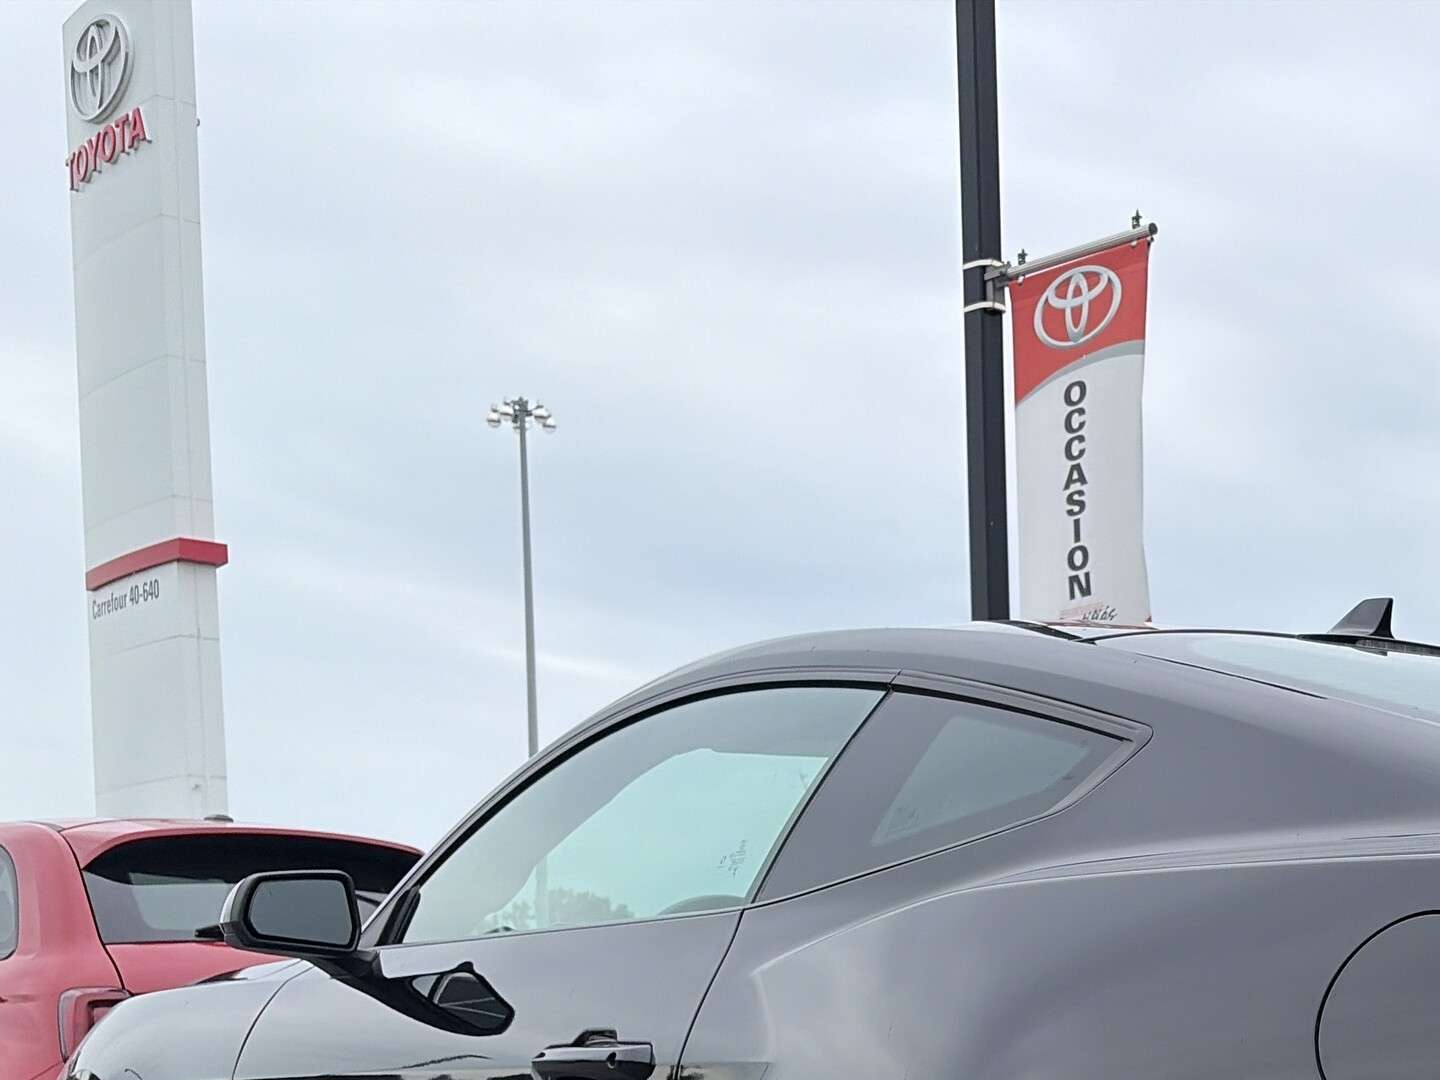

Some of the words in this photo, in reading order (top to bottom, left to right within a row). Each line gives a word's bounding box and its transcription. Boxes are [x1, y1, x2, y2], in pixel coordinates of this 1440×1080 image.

[66, 107, 150, 191] TOYOTA
[1063, 379, 1092, 600] OCCASION
[92, 592, 127, 620] Carrefour
[129, 579, 160, 606] 40-640
